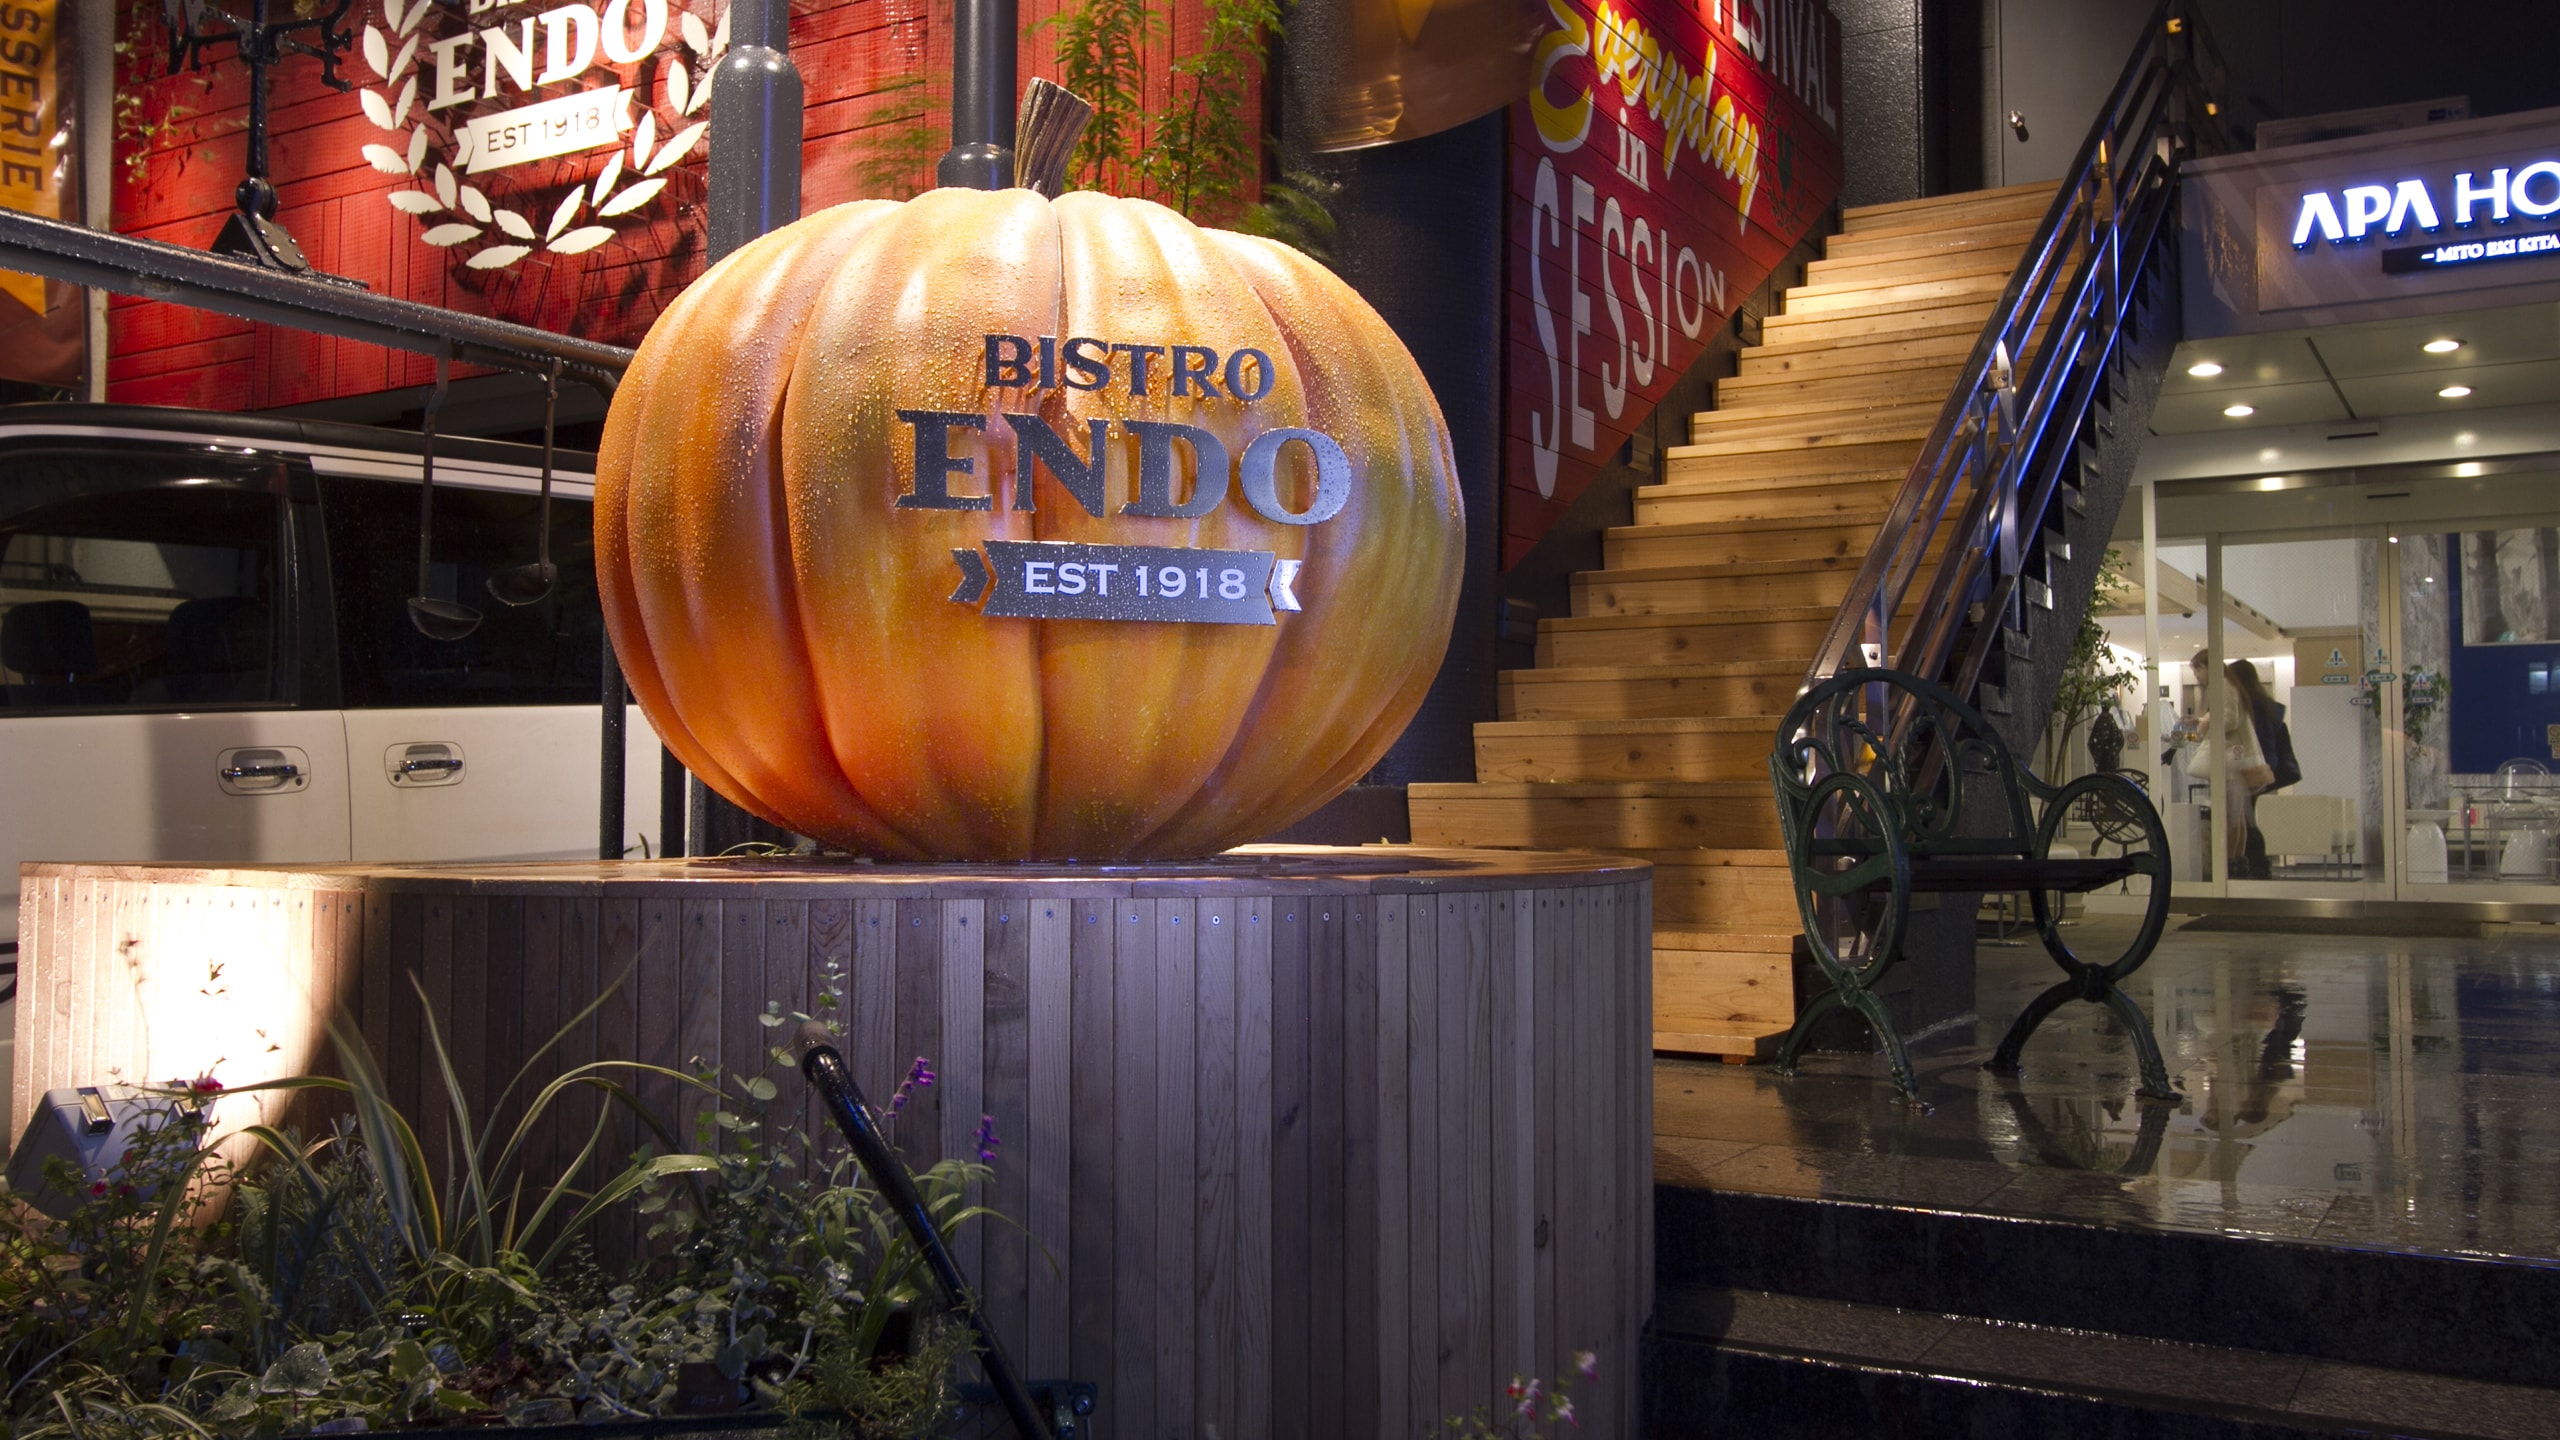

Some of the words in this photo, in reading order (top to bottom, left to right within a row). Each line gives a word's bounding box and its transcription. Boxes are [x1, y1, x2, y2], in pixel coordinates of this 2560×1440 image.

[0, 0, 43, 191] SSERIE
[427, 0, 668, 111] ENDO
[1714, 0, 1837, 137] STIVAL
[487, 122, 532, 153] EST
[542, 107, 600, 140] 1918
[1529, 0, 1760, 236] Everyday
[1616, 107, 1650, 193] in
[2293, 178, 2440, 245] APA
[2486, 239, 2517, 257] EKI
[982, 333, 1276, 401] BISTRO
[1531, 156, 1725, 500] SESSION
[895, 408, 1353, 527] ENDO
[1024, 561, 1119, 597] EST
[1135, 565, 1248, 600] 1918
